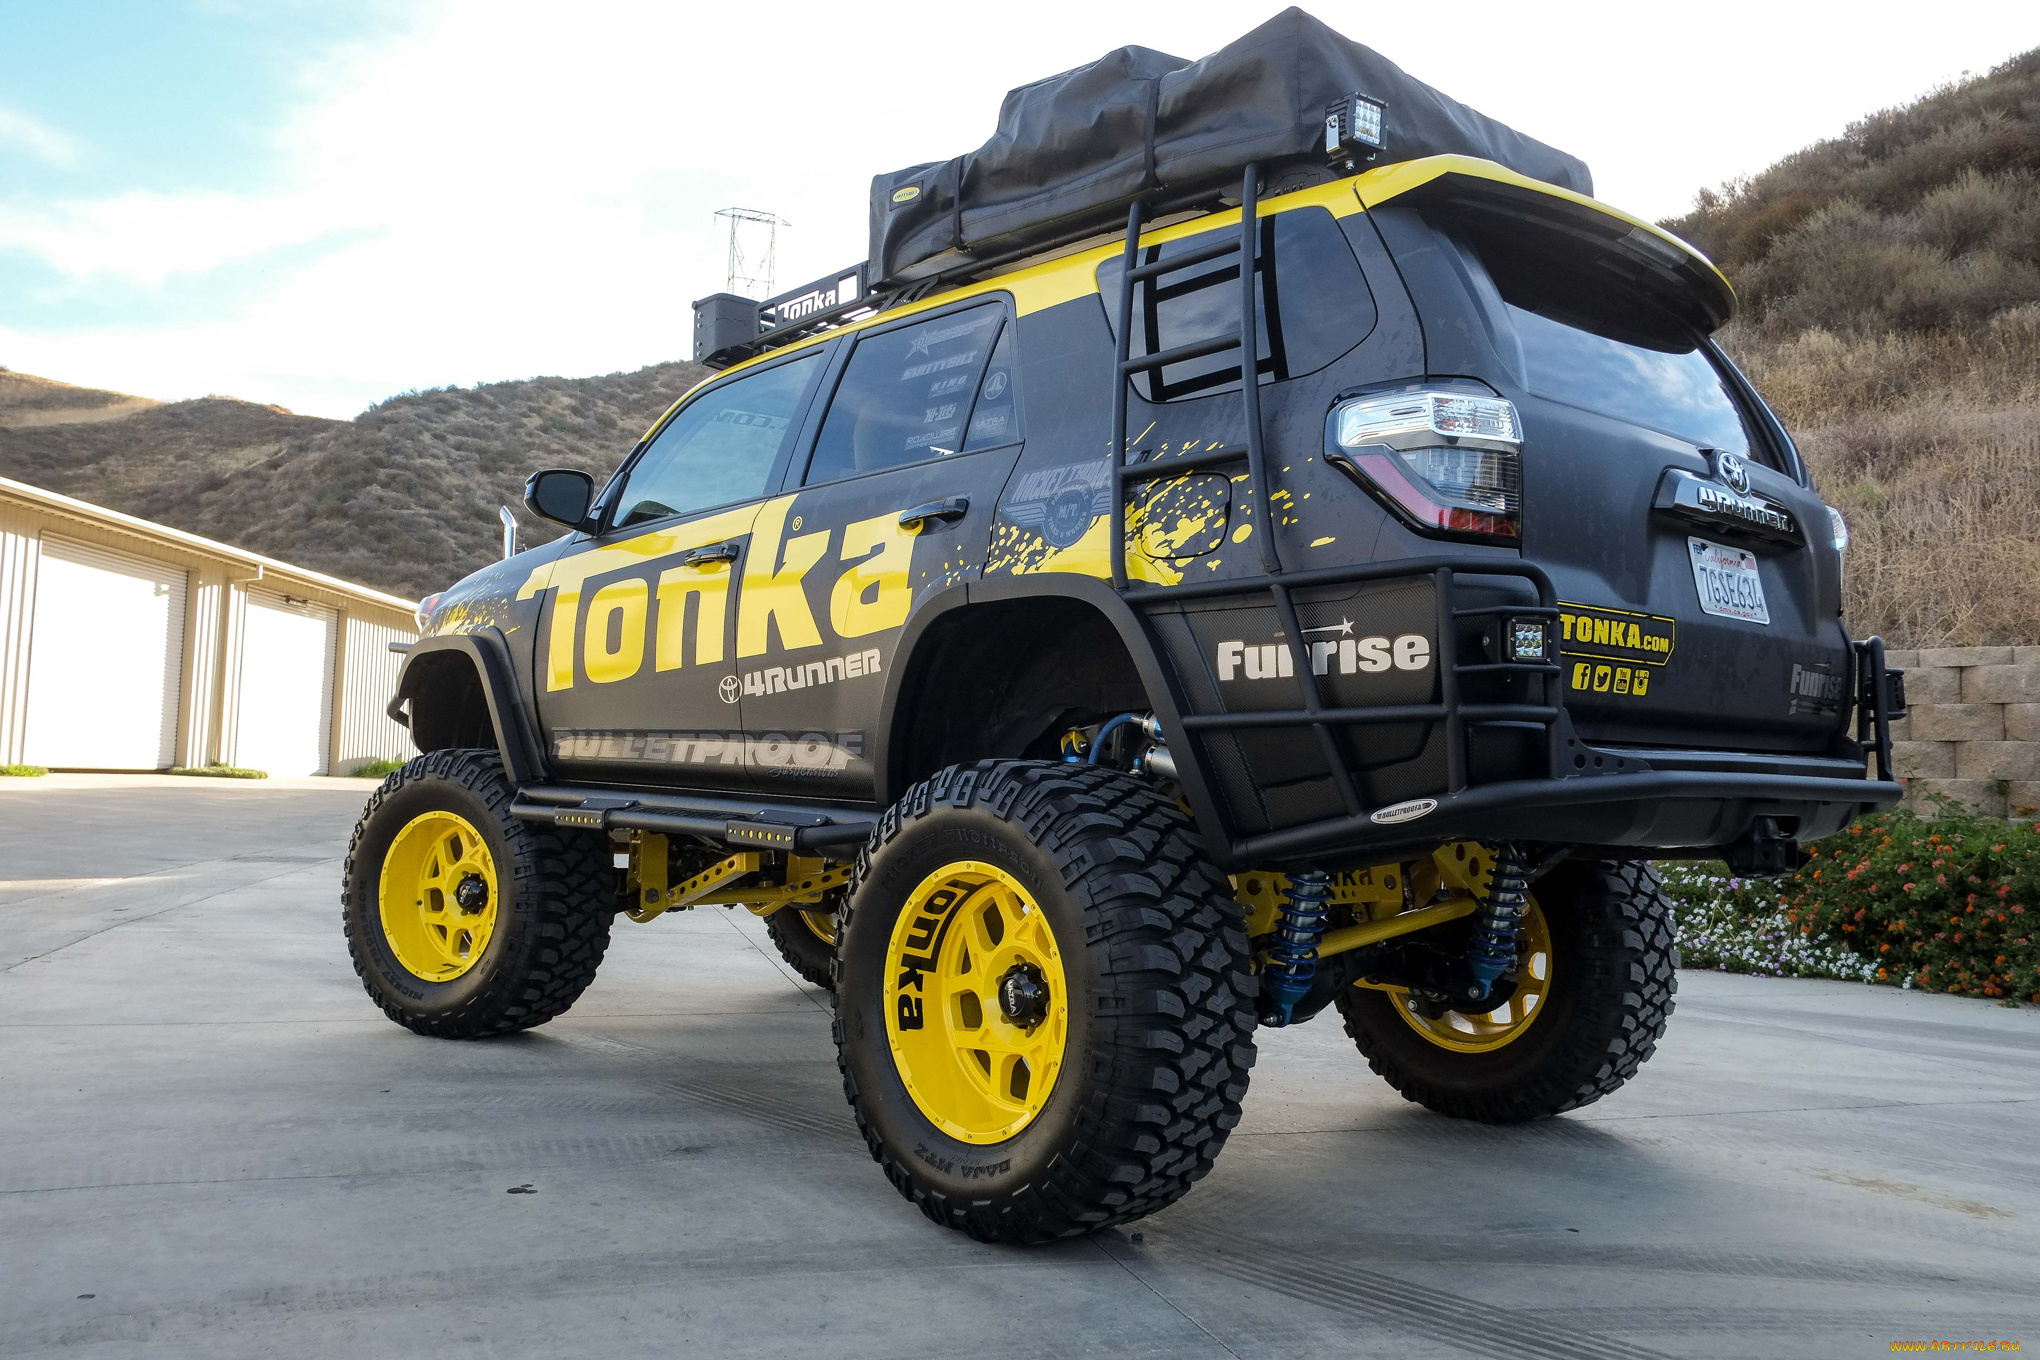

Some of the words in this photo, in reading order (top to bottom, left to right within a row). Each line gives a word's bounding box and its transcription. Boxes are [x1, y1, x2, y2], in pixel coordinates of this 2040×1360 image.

[778, 290, 836, 321] Tonka
[976, 416, 1005, 428] ULTRA
[1705, 548, 1746, 570] California
[516, 494, 924, 692] Tonka
[1699, 566, 1763, 612] 7GSE634
[1559, 613, 1669, 653] TONKA.COM
[1790, 663, 1842, 700] Funrise
[552, 728, 865, 770] BULLETPROOF
[897, 878, 1000, 1032] Tonka
[913, 1142, 954, 1175] MTZ
[961, 1158, 1011, 1180] BAJA
